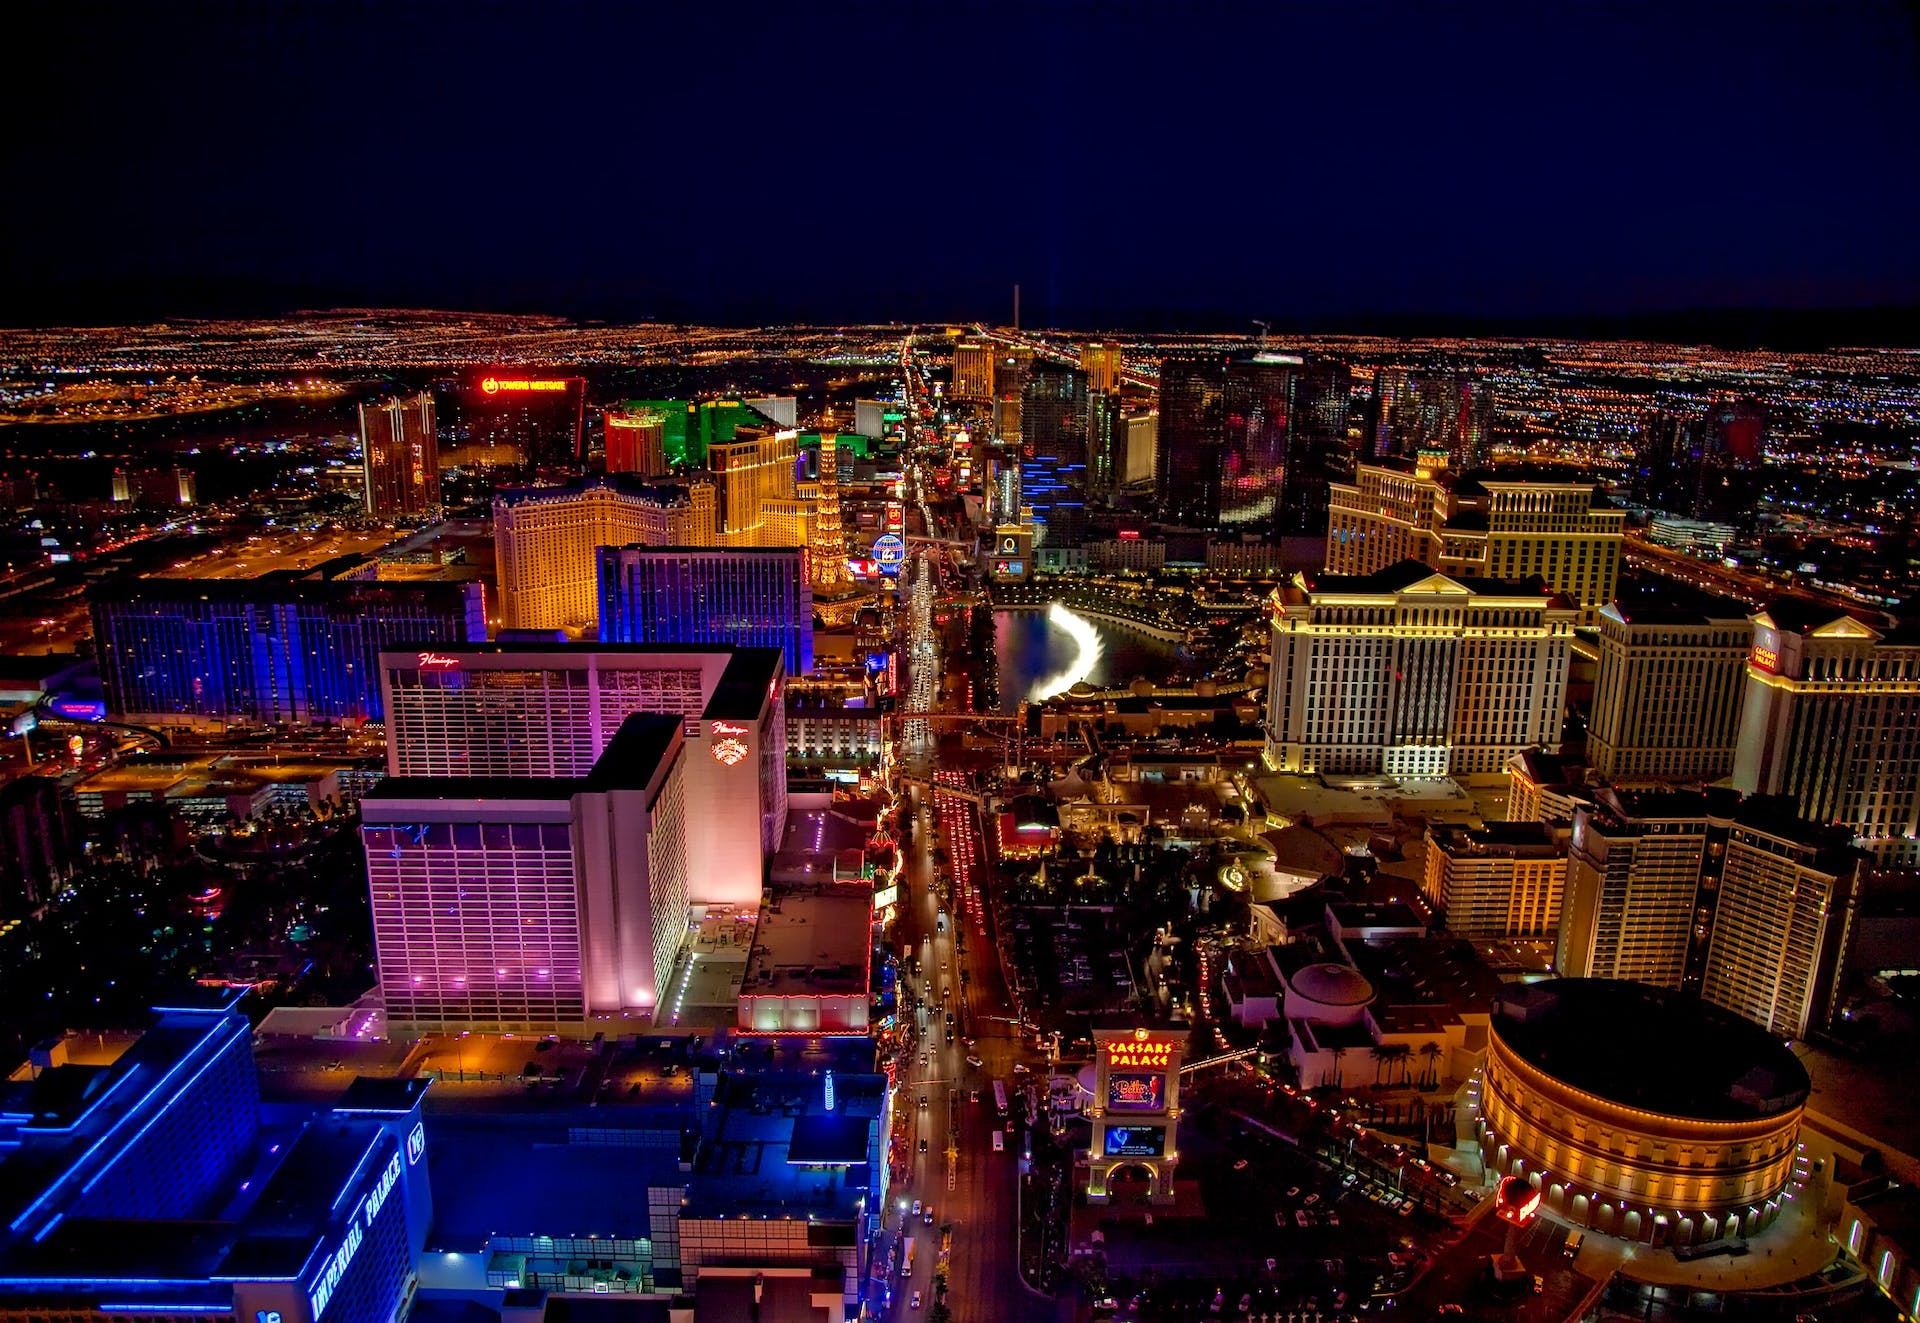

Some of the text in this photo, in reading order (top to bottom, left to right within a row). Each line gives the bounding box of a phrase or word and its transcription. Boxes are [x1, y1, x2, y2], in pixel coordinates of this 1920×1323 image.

[499, 380, 529, 391] TOWERS
[530, 380, 567, 391] WESTGATE
[417, 652, 460, 668] Flamingo
[1755, 653, 1775, 669] PALACE
[1108, 1042, 1172, 1054] CAESARS
[1110, 1054, 1168, 1066] PALACE
[310, 1150, 401, 1323] IMPERIAL PALACE
